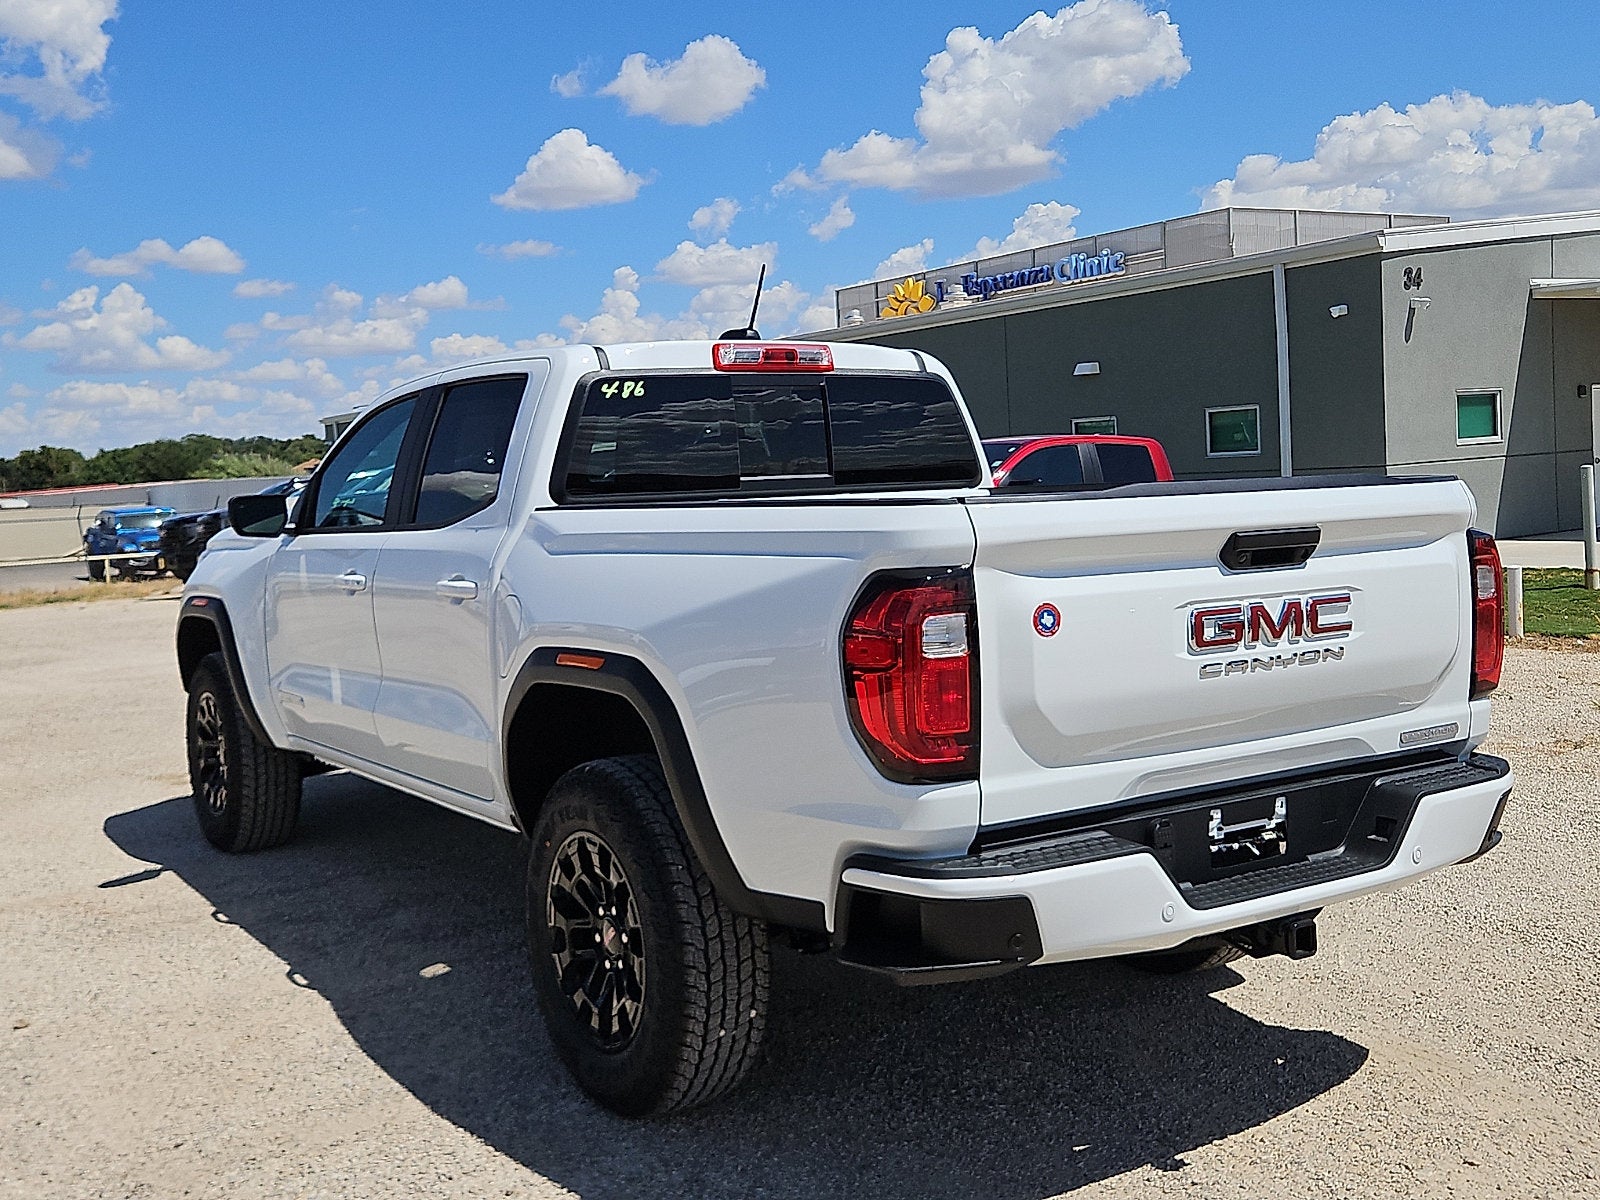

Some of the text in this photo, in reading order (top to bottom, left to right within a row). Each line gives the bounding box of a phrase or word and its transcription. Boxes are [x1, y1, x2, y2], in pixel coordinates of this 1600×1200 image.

[1054, 248, 1126, 284] Clinic
[1403, 266, 1424, 291] 34
[600, 380, 646, 399] 486
[1187, 592, 1353, 656] GMC
[1199, 646, 1345, 680] CANYON
